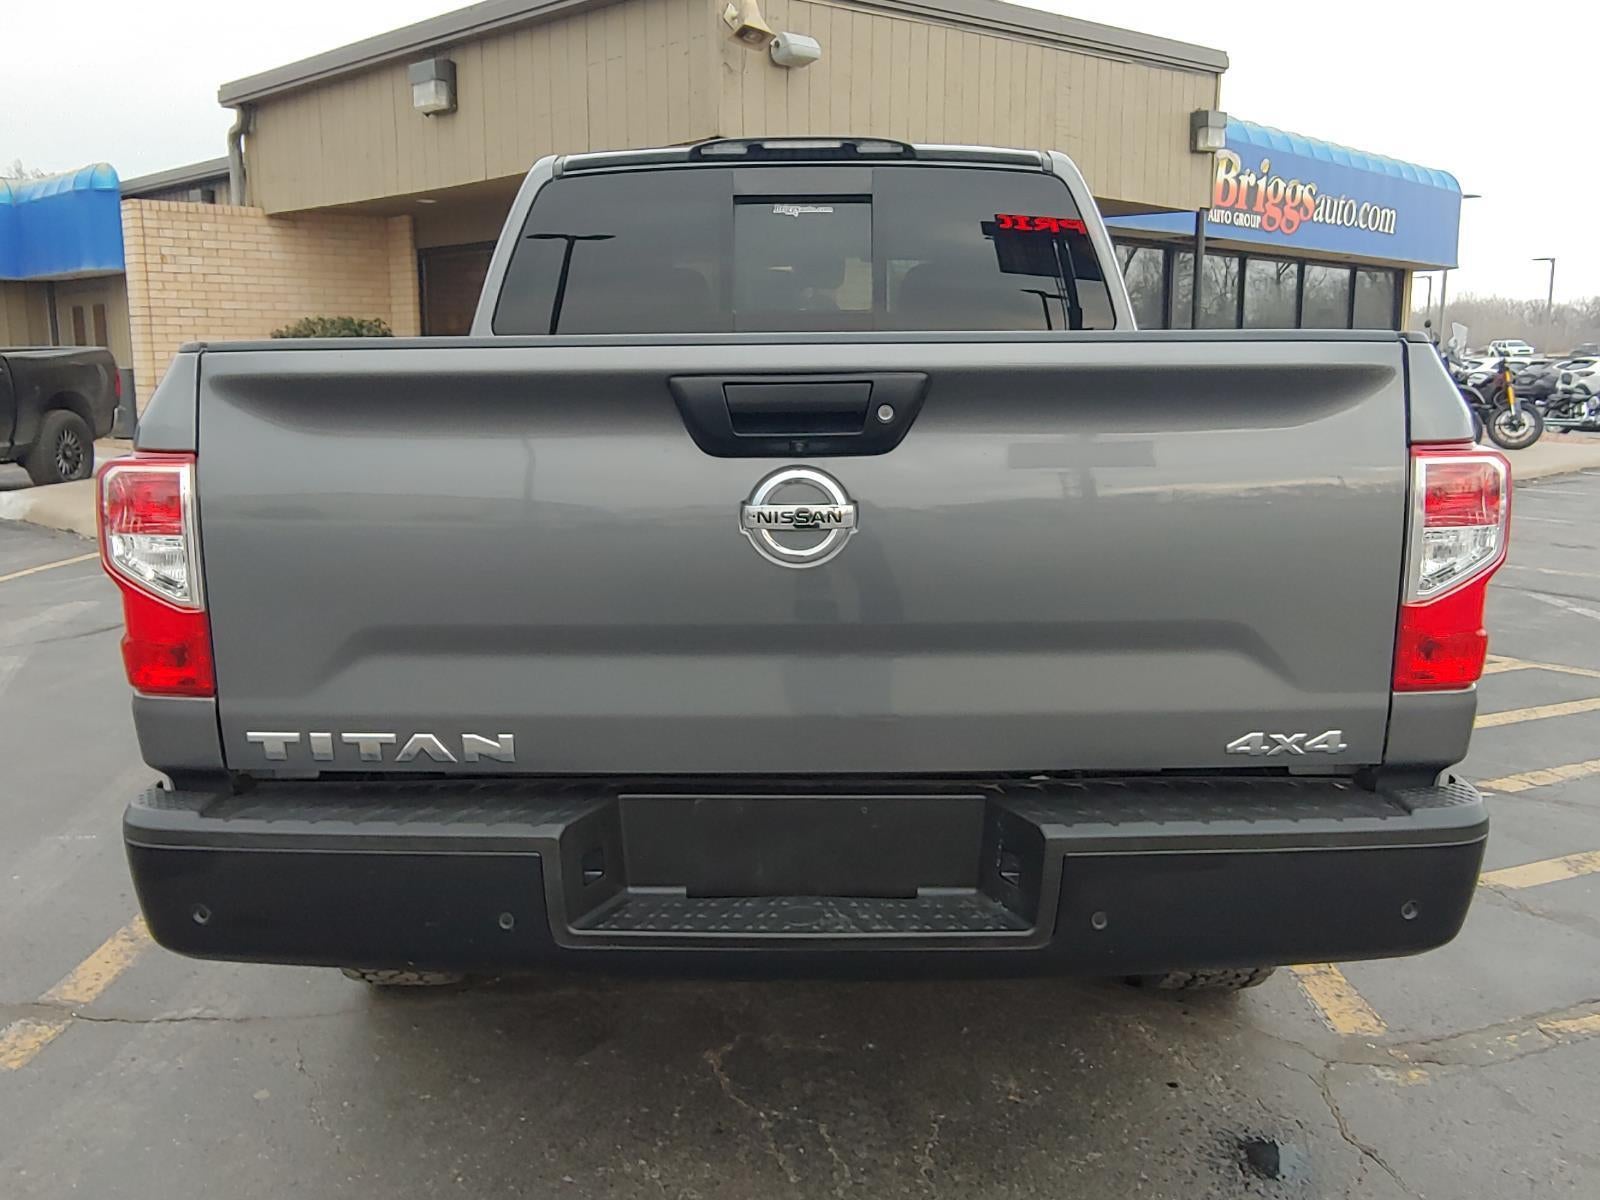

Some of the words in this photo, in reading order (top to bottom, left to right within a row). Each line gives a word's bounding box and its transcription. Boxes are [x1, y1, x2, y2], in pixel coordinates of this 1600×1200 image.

[1207, 208, 1232, 225] AUTO
[1233, 212, 1262, 229] GROUP
[757, 511, 842, 524] NISSAN
[246, 731, 516, 763] TITAN
